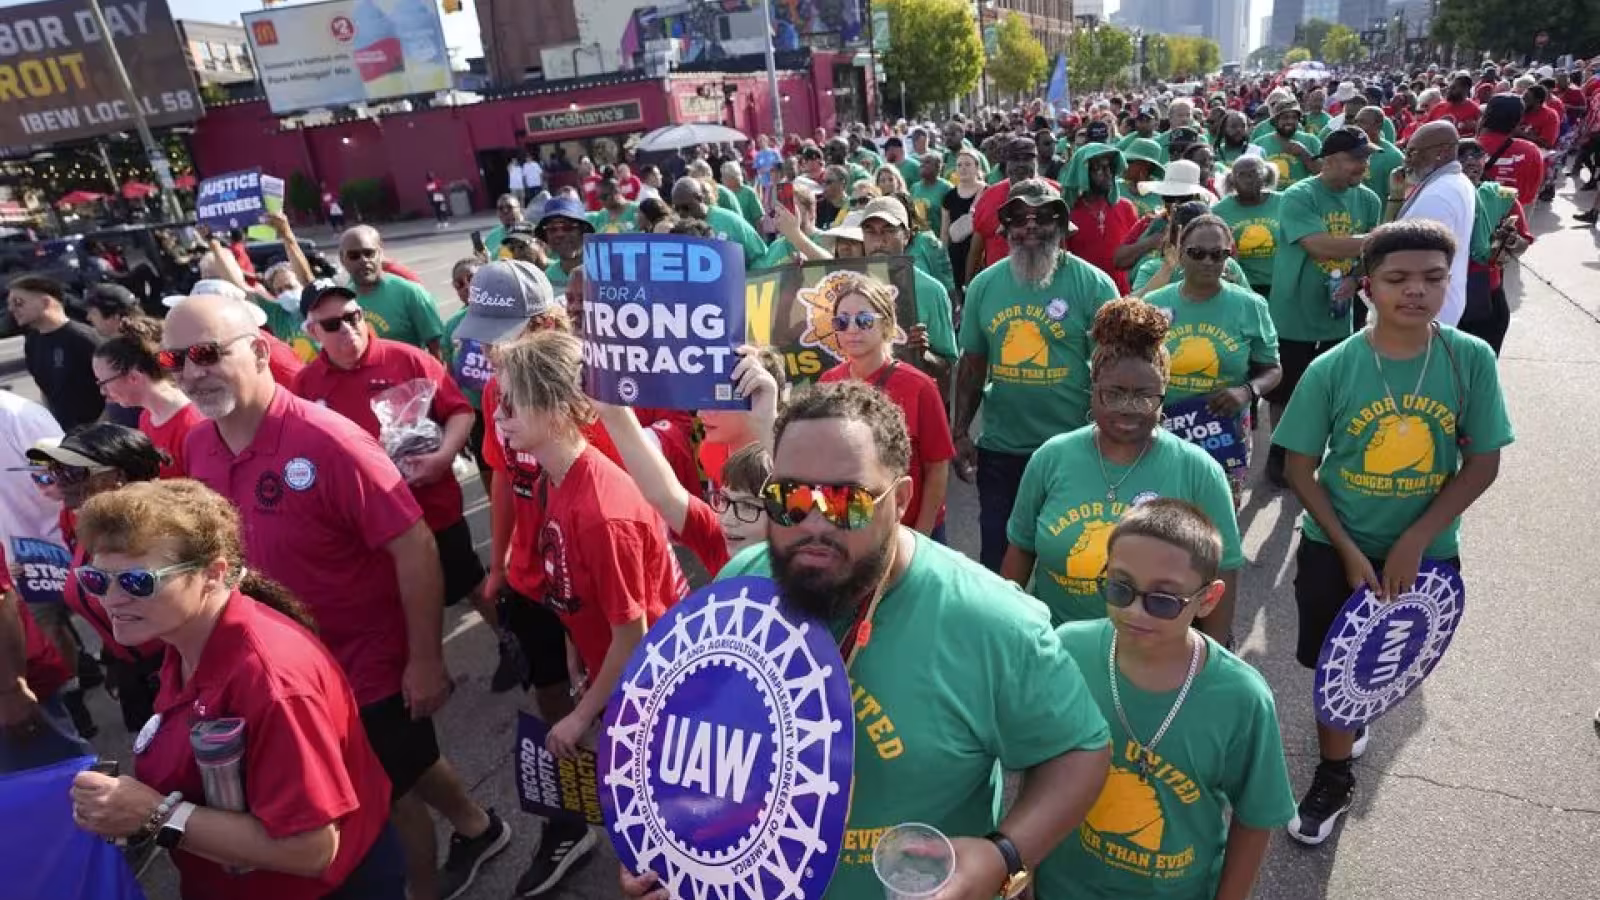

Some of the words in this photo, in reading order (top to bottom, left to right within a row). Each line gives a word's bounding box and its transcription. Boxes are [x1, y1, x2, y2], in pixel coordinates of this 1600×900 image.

[0, 15, 72, 57] BOR
[74, 2, 149, 43] DAY
[0, 52, 86, 101] ROIT
[19, 106, 81, 135] IBEW
[83, 95, 159, 125] LOCL
[160, 90, 194, 113] 58
[200, 172, 258, 198] JUSTICE
[200, 197, 261, 218] RETIREES
[584, 242, 722, 283] NITED
[600, 285, 629, 300] FOR
[634, 288, 646, 300] A
[583, 300, 725, 340] TRONG
[582, 341, 731, 374] ONTRACT
[1162, 411, 1198, 432] ERY
[1185, 421, 1222, 441] JOB
[1347, 397, 1397, 435] LABOR
[1402, 394, 1456, 434] UNITED
[1048, 502, 1103, 536] LABOR
[686, 645, 706, 660] AND
[707, 639, 769, 670] AGRICULTURAL
[1369, 620, 1414, 684] UAW
[767, 667, 794, 739] IMPLEMENT
[521, 738, 541, 802] RECORD
[538, 746, 560, 808] PROFITS
[660, 714, 762, 804] UAW
[1126, 740, 1200, 804] UNITED
[775, 746, 794, 817] WORKERS
[642, 805, 664, 847] UNITED
[768, 820, 779, 839] OF
[731, 839, 768, 876] AMERICA
[1105, 842, 1150, 869] THAN
